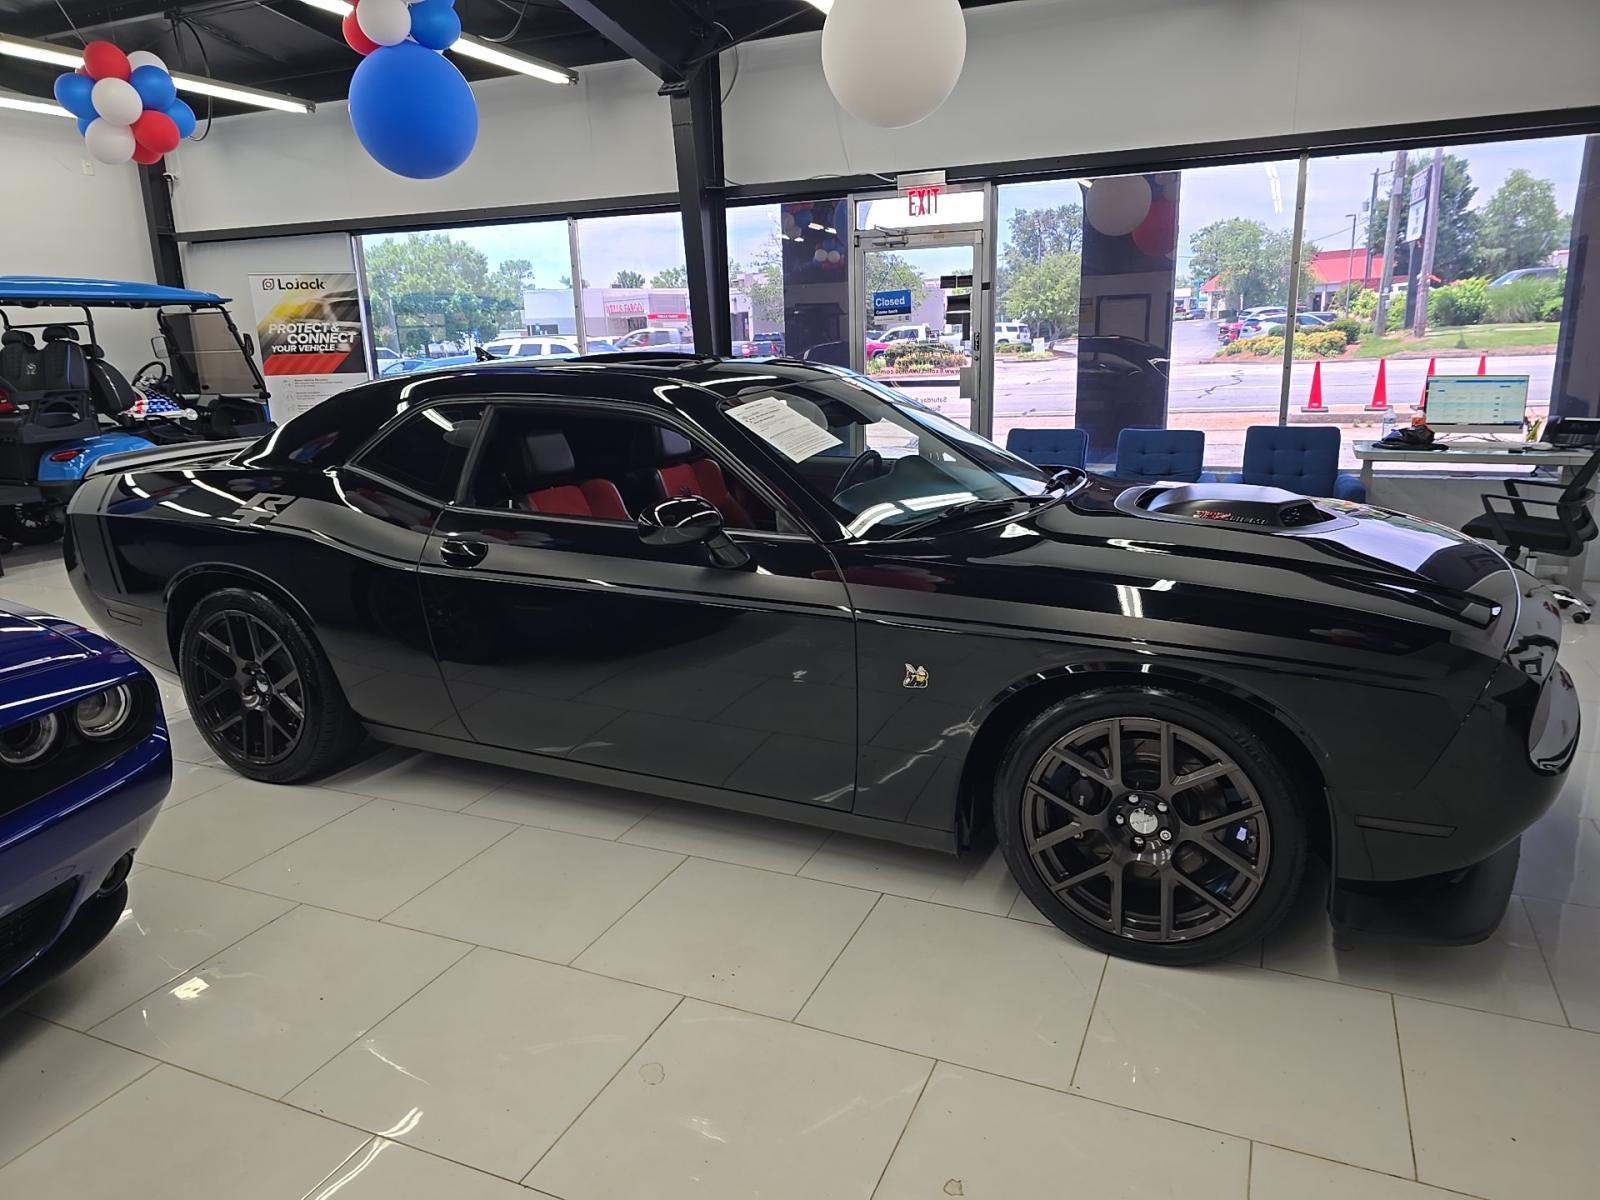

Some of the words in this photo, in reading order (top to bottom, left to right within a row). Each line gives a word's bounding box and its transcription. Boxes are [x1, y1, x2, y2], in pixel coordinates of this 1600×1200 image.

[908, 187, 940, 216] EXIT
[875, 296, 905, 307] Closed
[268, 322, 330, 335] PROTECT
[287, 332, 358, 345] CONNECT
[271, 345, 297, 353] YOUR
[298, 343, 336, 352] VEHICLE
